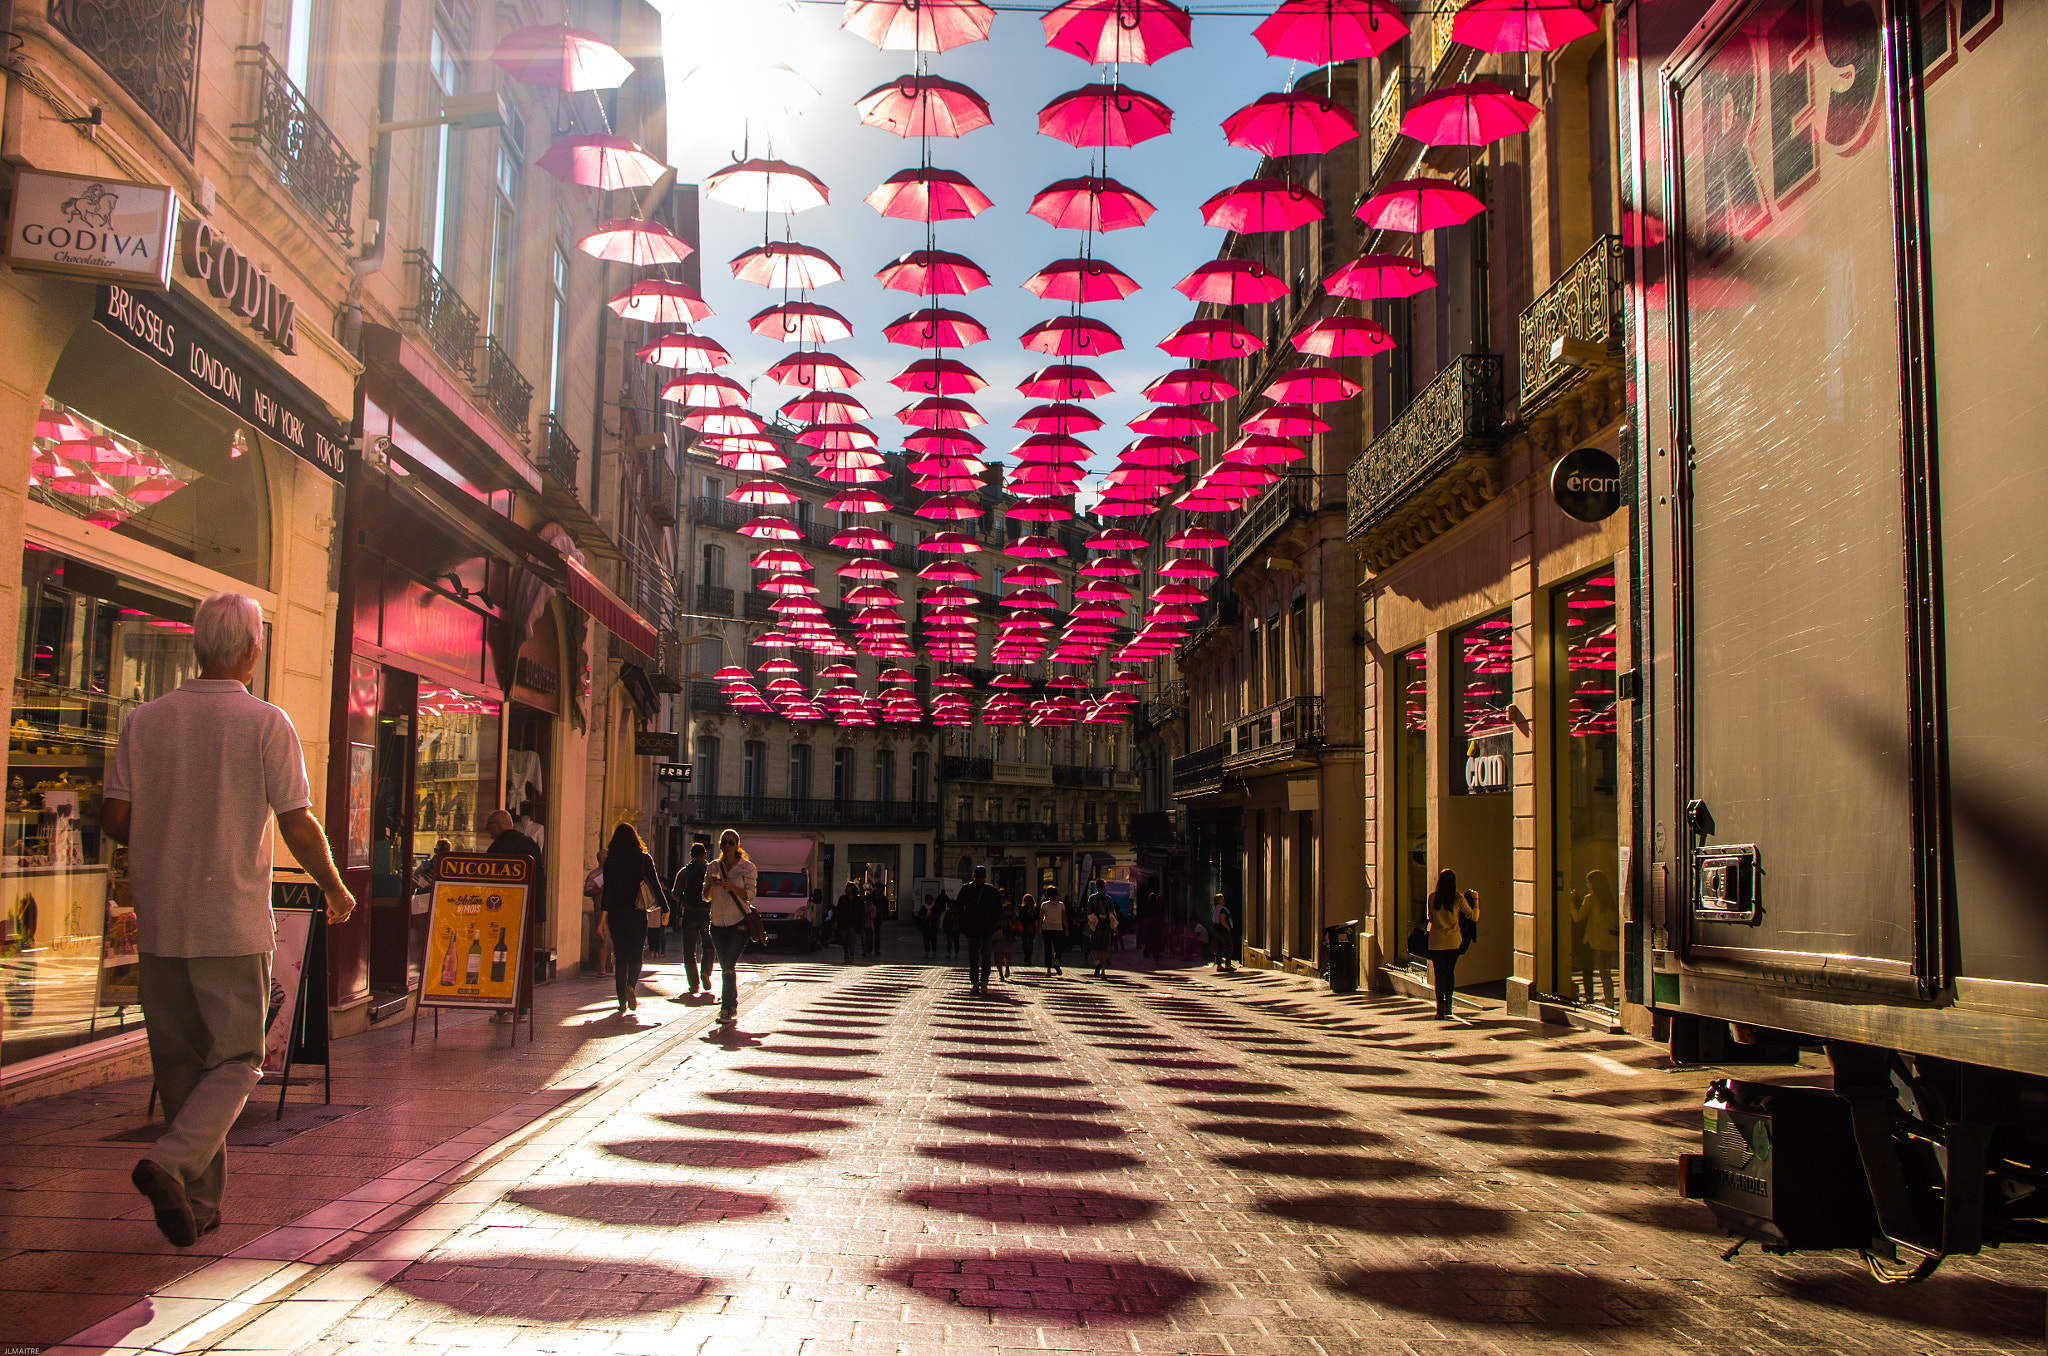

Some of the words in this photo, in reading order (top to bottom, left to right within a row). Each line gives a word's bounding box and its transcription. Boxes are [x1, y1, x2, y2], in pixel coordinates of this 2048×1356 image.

[22, 223, 149, 258] GODIVA
[53, 250, 116, 269] Chocolatier
[185, 218, 298, 356] GODIVA
[106, 284, 176, 358] BRUSSELS
[189, 342, 242, 404] LONDON
[254, 388, 278, 429] NEW
[280, 405, 305, 448] YORK
[315, 431, 346, 474] TOKYO
[1566, 469, 1620, 493] éram
[408, 596, 467, 659] NICOLAS
[660, 767, 691, 777] ERBÉ
[443, 860, 522, 878] NICOLAS
